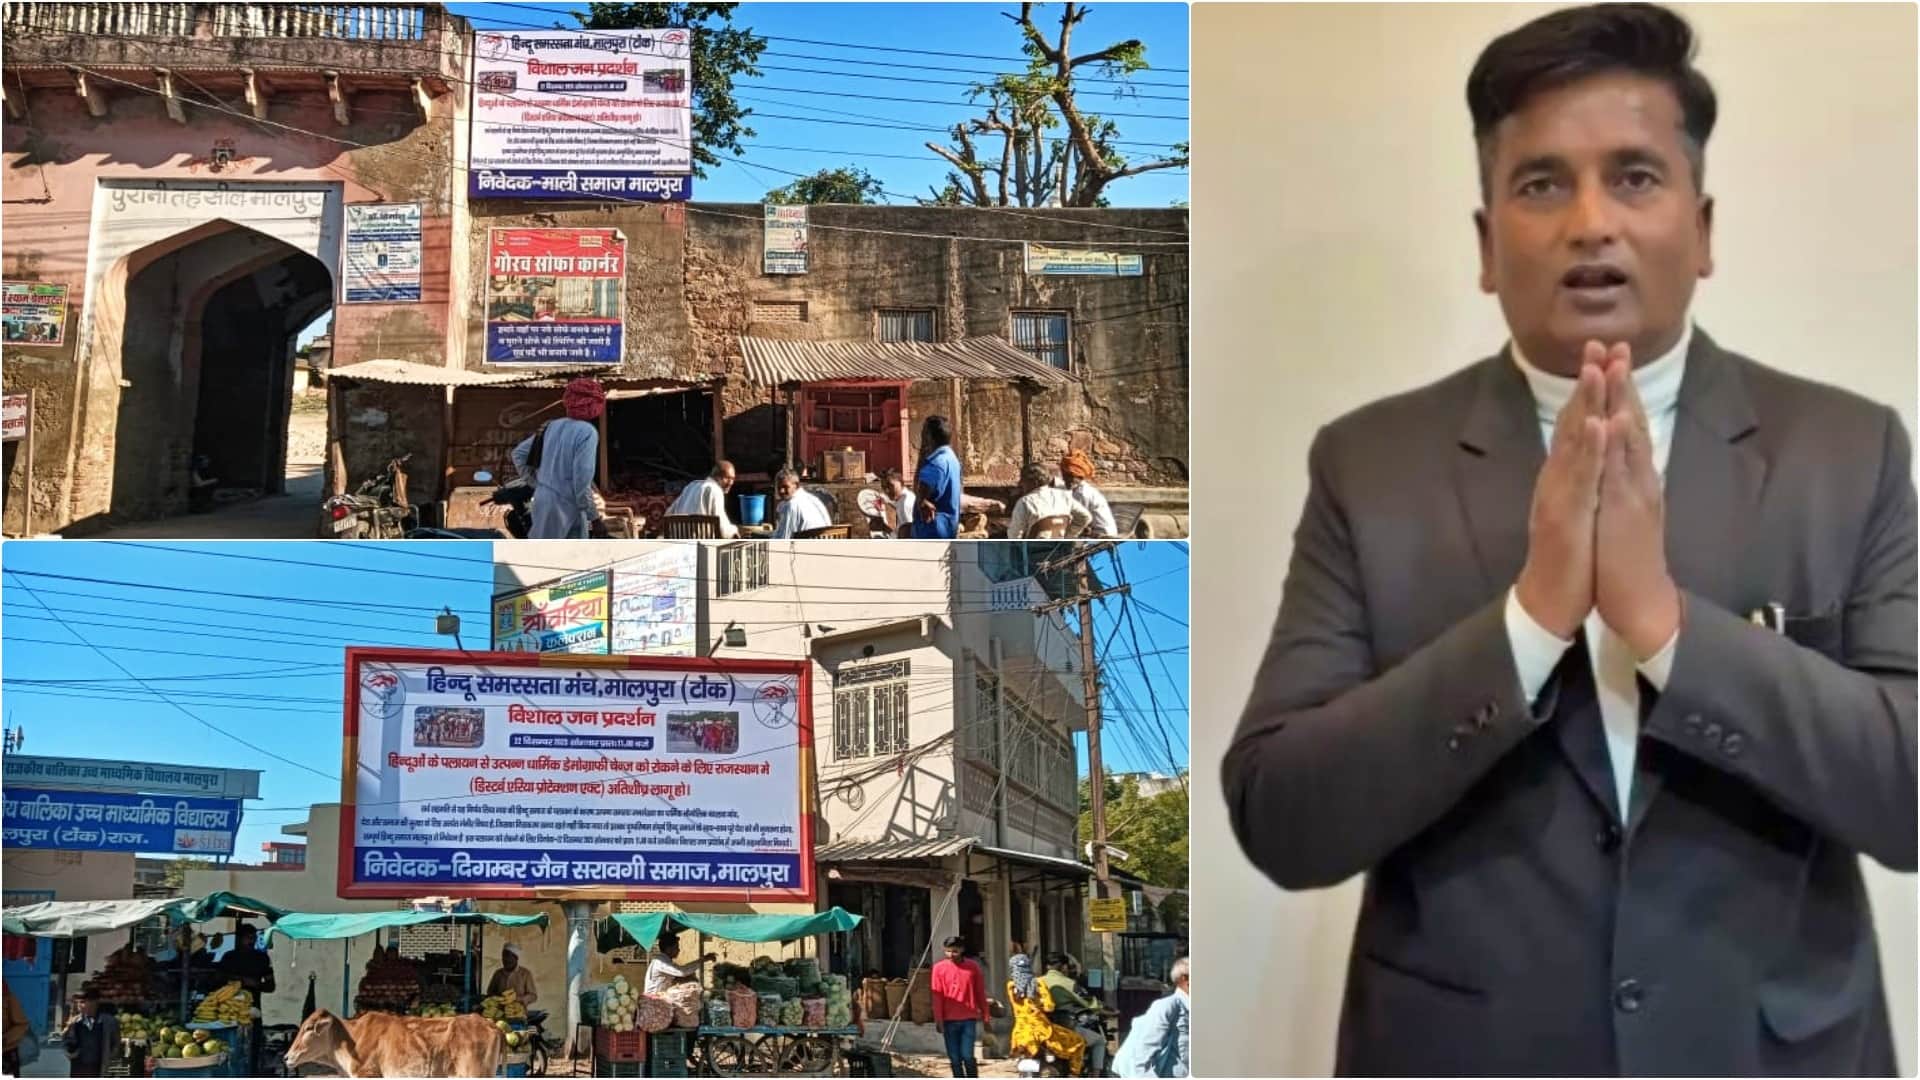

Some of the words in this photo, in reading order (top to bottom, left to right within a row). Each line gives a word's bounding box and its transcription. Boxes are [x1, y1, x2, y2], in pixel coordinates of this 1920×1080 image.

[511, 34, 534, 54] हिन्दू
[527, 58, 568, 76] विशाल
[572, 63, 594, 76] जन
[597, 57, 638, 77] प्रदर्शन
[112, 181, 167, 212] पुरानी
[478, 170, 577, 192] निवेदक-माली
[580, 176, 625, 191] समाज
[629, 176, 683, 199] मालपुरा
[494, 250, 532, 272] गौरव
[534, 250, 575, 272] सोफा
[577, 251, 619, 272] कार्नर
[426, 667, 476, 701] हिन्दू
[680, 674, 737, 706] (टोंक)
[507, 704, 562, 725] विशाल
[567, 711, 598, 724] जन
[601, 707, 656, 728] प्रदर्शन
[6, 761, 43, 775] राजकीय
[45, 762, 80, 777] बालिका
[81, 766, 98, 778] उच्च
[100, 766, 142, 780] माध्यमिक
[144, 767, 182, 784] विद्यालय
[183, 773, 218, 789] मालपुरा
[428, 754, 440, 768] के
[441, 757, 478, 769] पलायन
[479, 755, 489, 769] से
[492, 758, 525, 770] उत्पन्न
[527, 755, 561, 770] धार्मिक
[562, 756, 608, 773] डेमोग्राफी
[635, 758, 650, 772] को
[651, 758, 680, 773] रोकने
[681, 759, 692, 773] के
[694, 759, 714, 775] लिए
[715, 763, 759, 775] राजस्थान
[507, 777, 535, 793] एरिया
[580, 780, 604, 799] एक्ट)
[607, 780, 649, 797] अतिशीघ्र
[650, 784, 675, 800] लागू
[20, 793, 72, 822] बालिका
[74, 803, 102, 823] उच्च
[105, 799, 172, 826] माध्यमिक
[173, 800, 230, 828] विद्यालय
[3, 827, 49, 846] लपुरा
[364, 850, 528, 879] निवेदक-दिगम्बर
[531, 853, 568, 879] जैन
[571, 854, 647, 881] सरावगी
